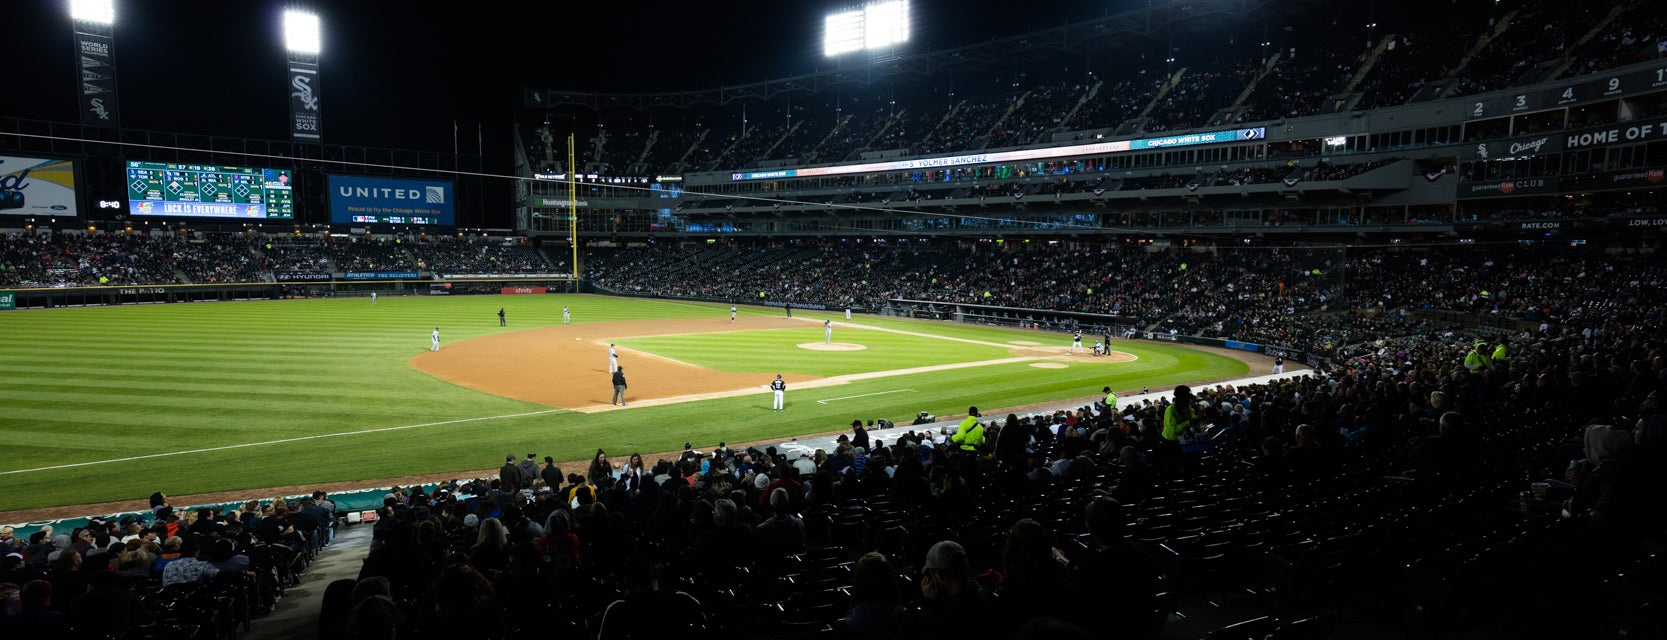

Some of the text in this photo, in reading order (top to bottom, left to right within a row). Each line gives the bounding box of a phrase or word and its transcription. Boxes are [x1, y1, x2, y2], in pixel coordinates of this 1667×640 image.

[80, 41, 108, 49] WORLD
[81, 45, 108, 54] SERIES
[1608, 78, 1620, 90] 9
[1562, 87, 1573, 98] 4
[1516, 95, 1526, 106] 3
[1475, 103, 1483, 113] 2
[1568, 129, 1618, 148] HOME
[1625, 125, 1653, 140] OF
[1510, 137, 1549, 154] Chicago
[951, 155, 987, 164] SANCHEZ
[1613, 171, 1648, 182] guaranteed
[1472, 183, 1500, 192] guaranteed
[1516, 179, 1544, 188] CLUB
[340, 186, 420, 199] UNITED
[164, 204, 182, 213] LUCK
[193, 205, 237, 214] EVERYWHERE
